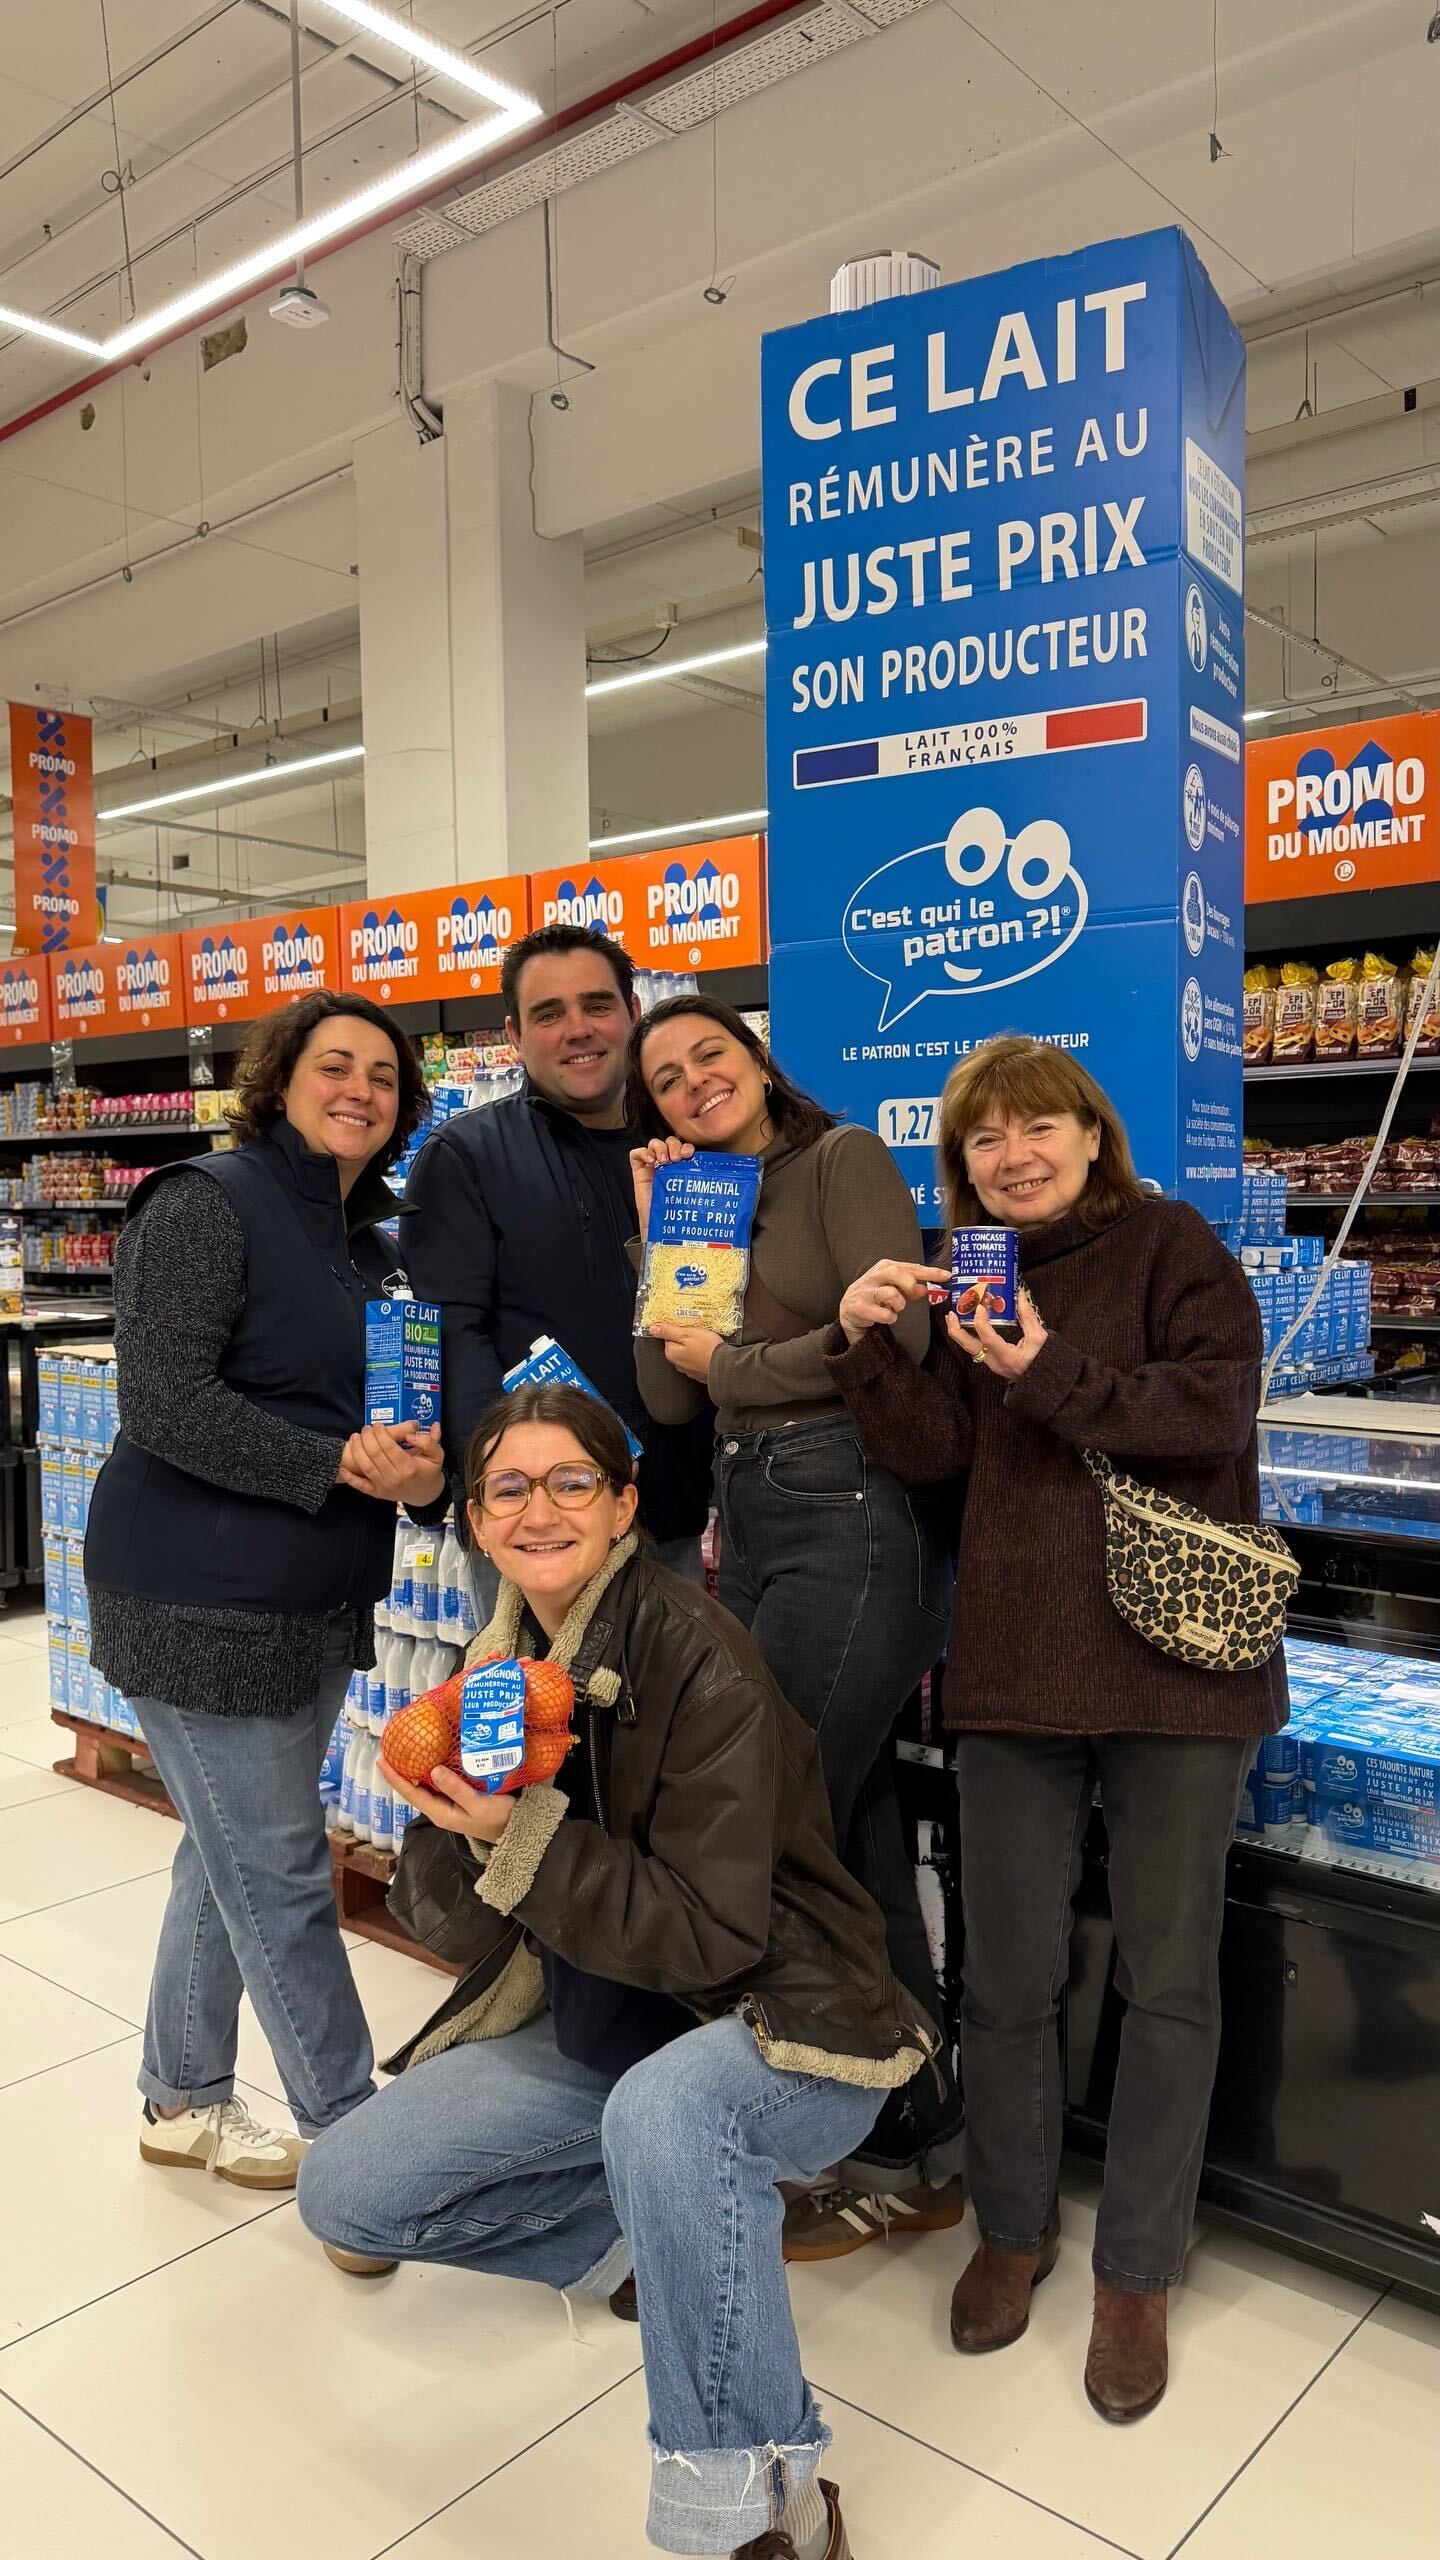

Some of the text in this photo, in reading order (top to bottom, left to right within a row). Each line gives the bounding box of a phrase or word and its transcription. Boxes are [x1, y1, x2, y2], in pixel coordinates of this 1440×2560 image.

[788, 281, 1147, 441] CE LAIT
[789, 407, 1148, 526] RÉMUNÈRE AU
[792, 496, 1148, 631] JUSTE PRIX
[791, 607, 1148, 713] SON PRODUCTEUR
[904, 721, 1018, 751] LAIT 100%
[28, 752, 76, 776] PROMO
[908, 740, 1015, 768] FRANÇAIS
[1268, 757, 1425, 824] PROMO
[31, 823, 78, 846] PROMO
[1268, 814, 1426, 862] DU MOMENT
[33, 895, 80, 915] PROMO
[647, 873, 740, 919] PROMO
[544, 890, 624, 928] PROMO
[851, 898, 994, 931] C'est qui le
[437, 907, 512, 947] PROMO
[649, 925, 669, 948] DU
[672, 915, 741, 945] MOMENT
[350, 921, 418, 959] PROMO
[191, 946, 248, 981] PROMO
[262, 934, 324, 971] PROMO
[438, 952, 455, 973] DU
[116, 959, 170, 991] PROMO
[264, 969, 326, 994] DU MOMENT
[352, 957, 420, 983] DU MOMENT
[56, 968, 104, 999] PROMO
[193, 979, 249, 1003] DU MOMENT
[58, 999, 106, 1020] DU MOMENT
[119, 991, 171, 1012] DU MOMENT
[8, 1008, 40, 1025] MOMENT
[842, 1040, 971, 1061] LE PATRON C'EST LE
[888, 1104, 934, 1144] 1,27
[665, 1178, 740, 1196] CET EMMENTAL
[665, 1196, 739, 1209] RÉMUNÈRE AU
[664, 1209, 736, 1225] JUSTE PRIX
[663, 1225, 734, 1238] SON PRODUCTEUR
[961, 1232, 1007, 1242] CE CONCASSÉ
[960, 1242, 1007, 1252] DE TOMATES
[404, 1304, 416, 1319] CE
[418, 1306, 440, 1322] LAIT
[404, 1322, 422, 1342] BIO
[403, 1355, 440, 1371] JUSTE PRIX
[529, 1353, 562, 1383] LAIT
[560, 1366, 572, 1379] AU
[485, 1669, 521, 1681] OIGNONS
[465, 1690, 520, 1700] JUSTE PRIX
[1366, 1757, 1434, 1780] CES YAOURTS NATURE
[1366, 1778, 1434, 1799] JUSTE PRIX
[1380, 1790, 1413, 1802] PRODUCTEUR
[1373, 1825, 1440, 1846] JUSTE PRIX
